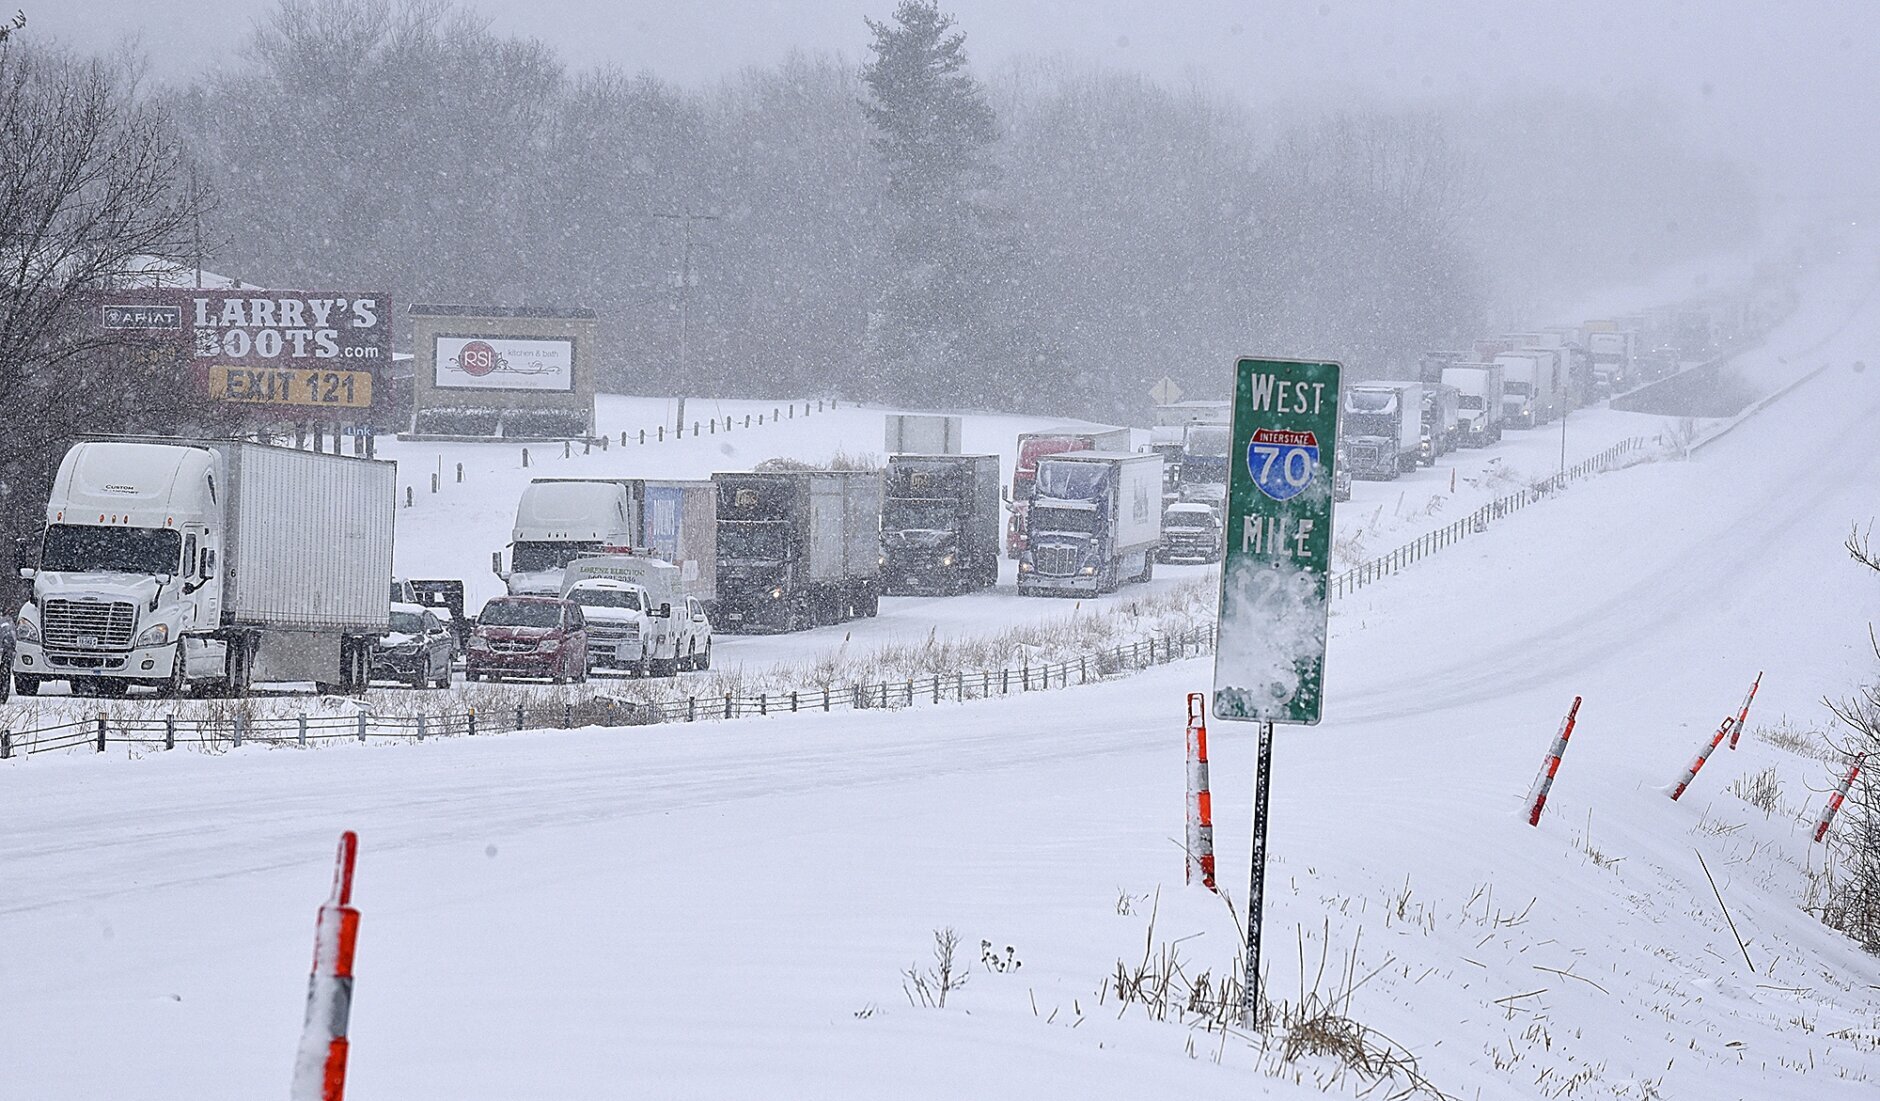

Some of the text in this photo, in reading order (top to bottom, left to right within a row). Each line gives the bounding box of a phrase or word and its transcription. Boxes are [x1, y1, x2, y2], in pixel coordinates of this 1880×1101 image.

[122, 313, 175, 323] ARIAT
[193, 299, 377, 328] LARRY'S
[464, 350, 492, 367] RSI
[226, 370, 355, 403] EXIT 121
[1250, 373, 1325, 415] WEST
[1260, 432, 1310, 445] INTERSTATE
[1254, 446, 1311, 488] 70
[1242, 515, 1314, 557] MILE
[231, 568, 237, 578] 6
